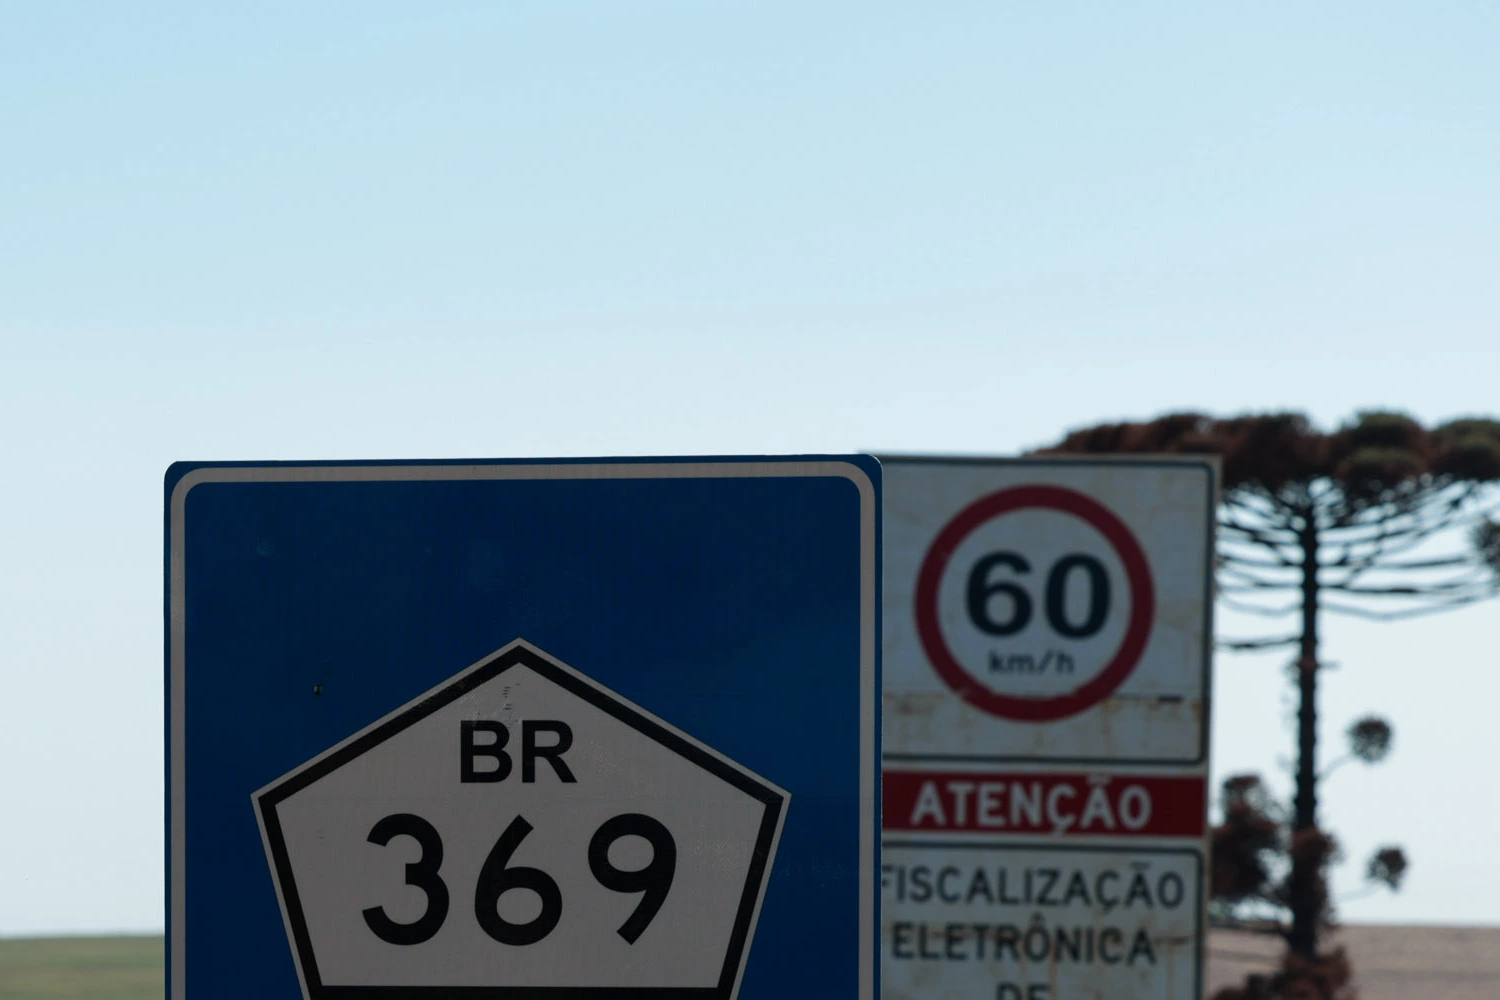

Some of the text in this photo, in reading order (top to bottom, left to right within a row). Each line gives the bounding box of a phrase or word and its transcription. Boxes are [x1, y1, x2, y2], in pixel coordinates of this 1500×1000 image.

[965, 550, 1112, 639] 60
[988, 650, 1075, 675] km/h
[458, 719, 578, 784] BR
[910, 774, 1152, 833] ATENÇÃO
[361, 812, 677, 946] 369
[892, 912, 1157, 966] ELETRÔNICA
